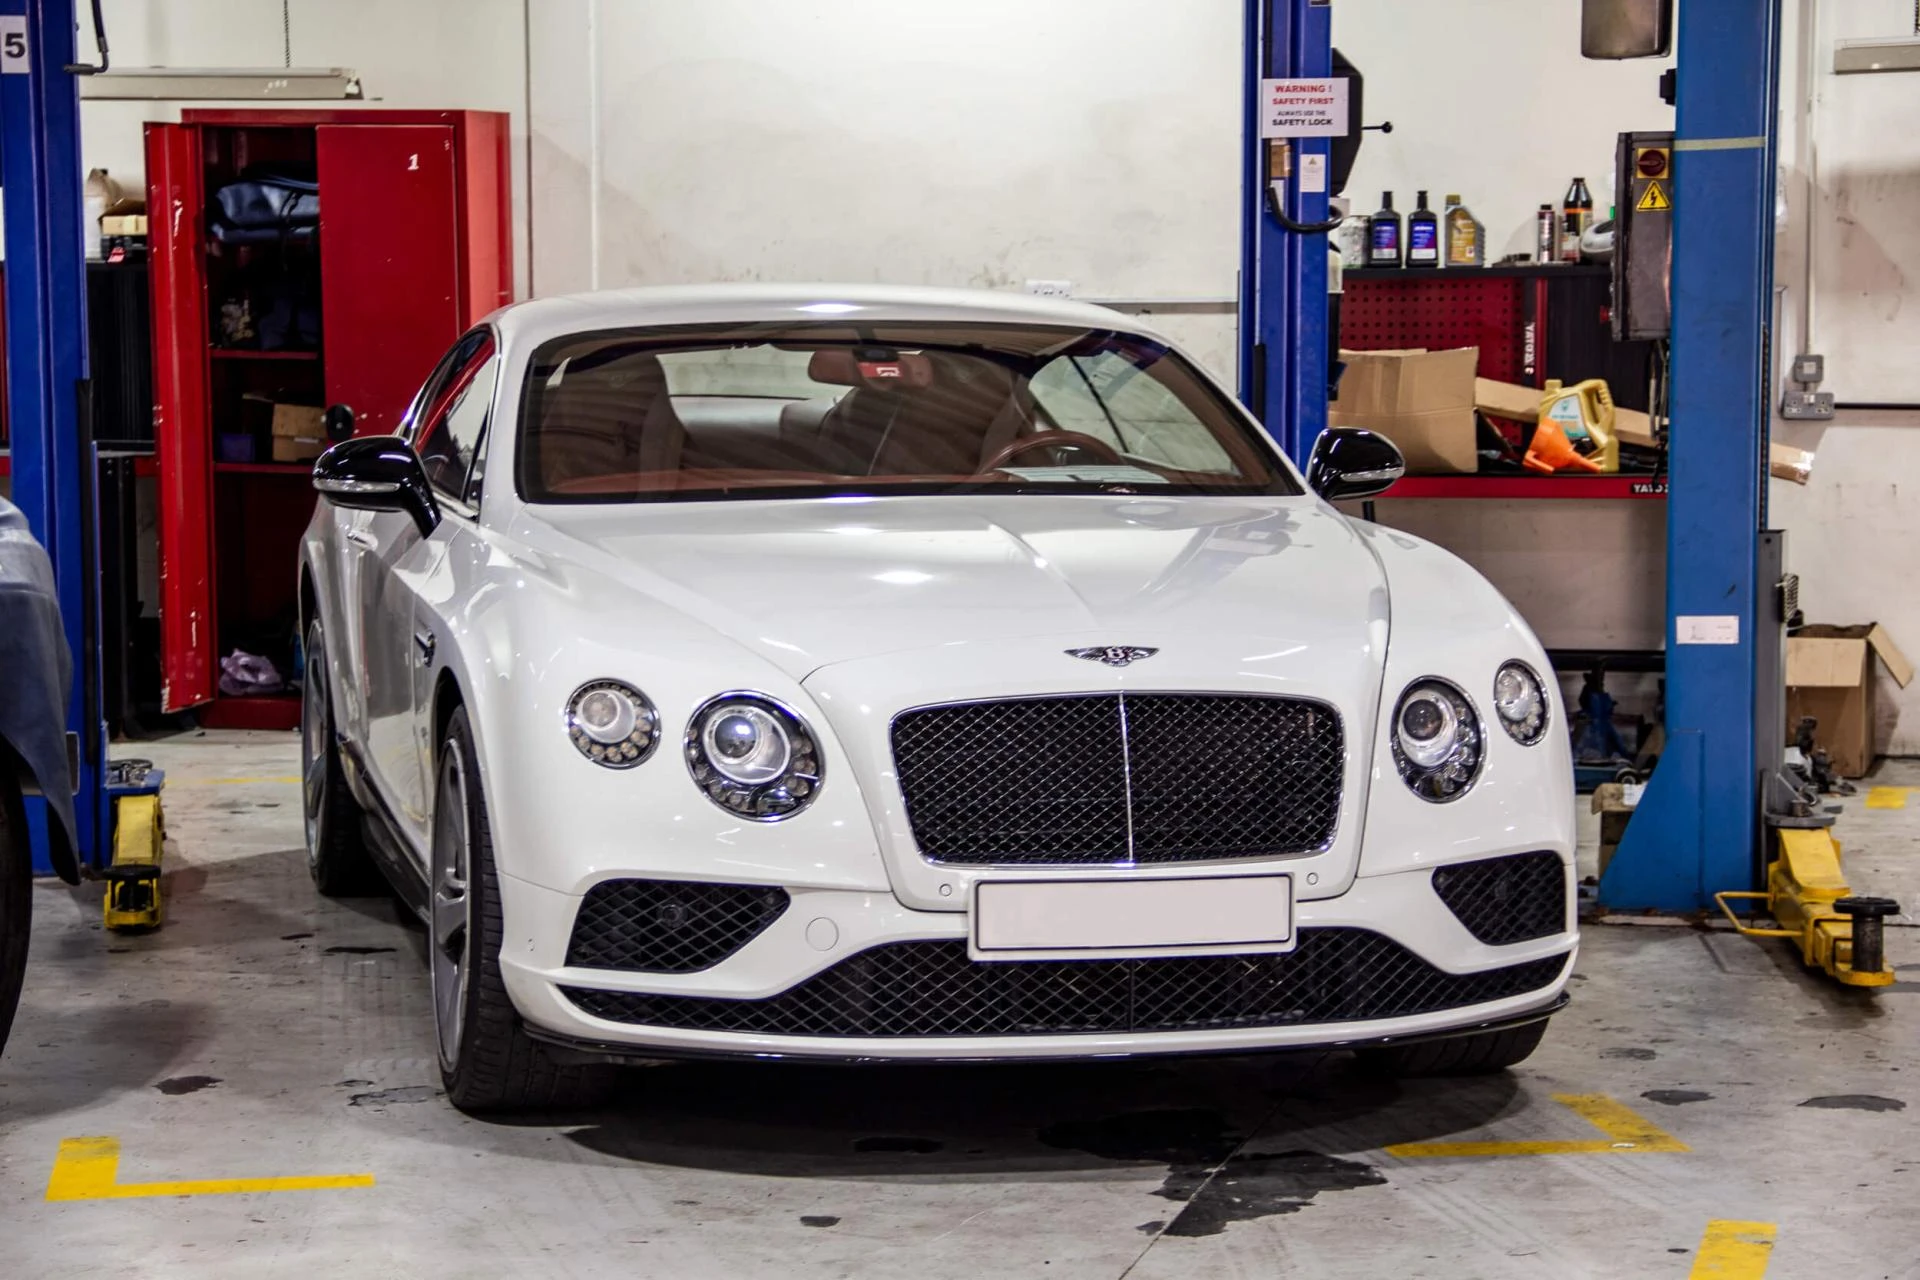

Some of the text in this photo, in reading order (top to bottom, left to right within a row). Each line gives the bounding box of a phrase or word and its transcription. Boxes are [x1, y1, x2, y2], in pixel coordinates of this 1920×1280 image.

[5, 32, 26, 59] 5
[1275, 84, 1326, 93] WARNING
[1272, 97, 1335, 105] SAFETY FIRST
[1272, 118, 1333, 126] SAFETY LOCK
[407, 153, 420, 171] 1
